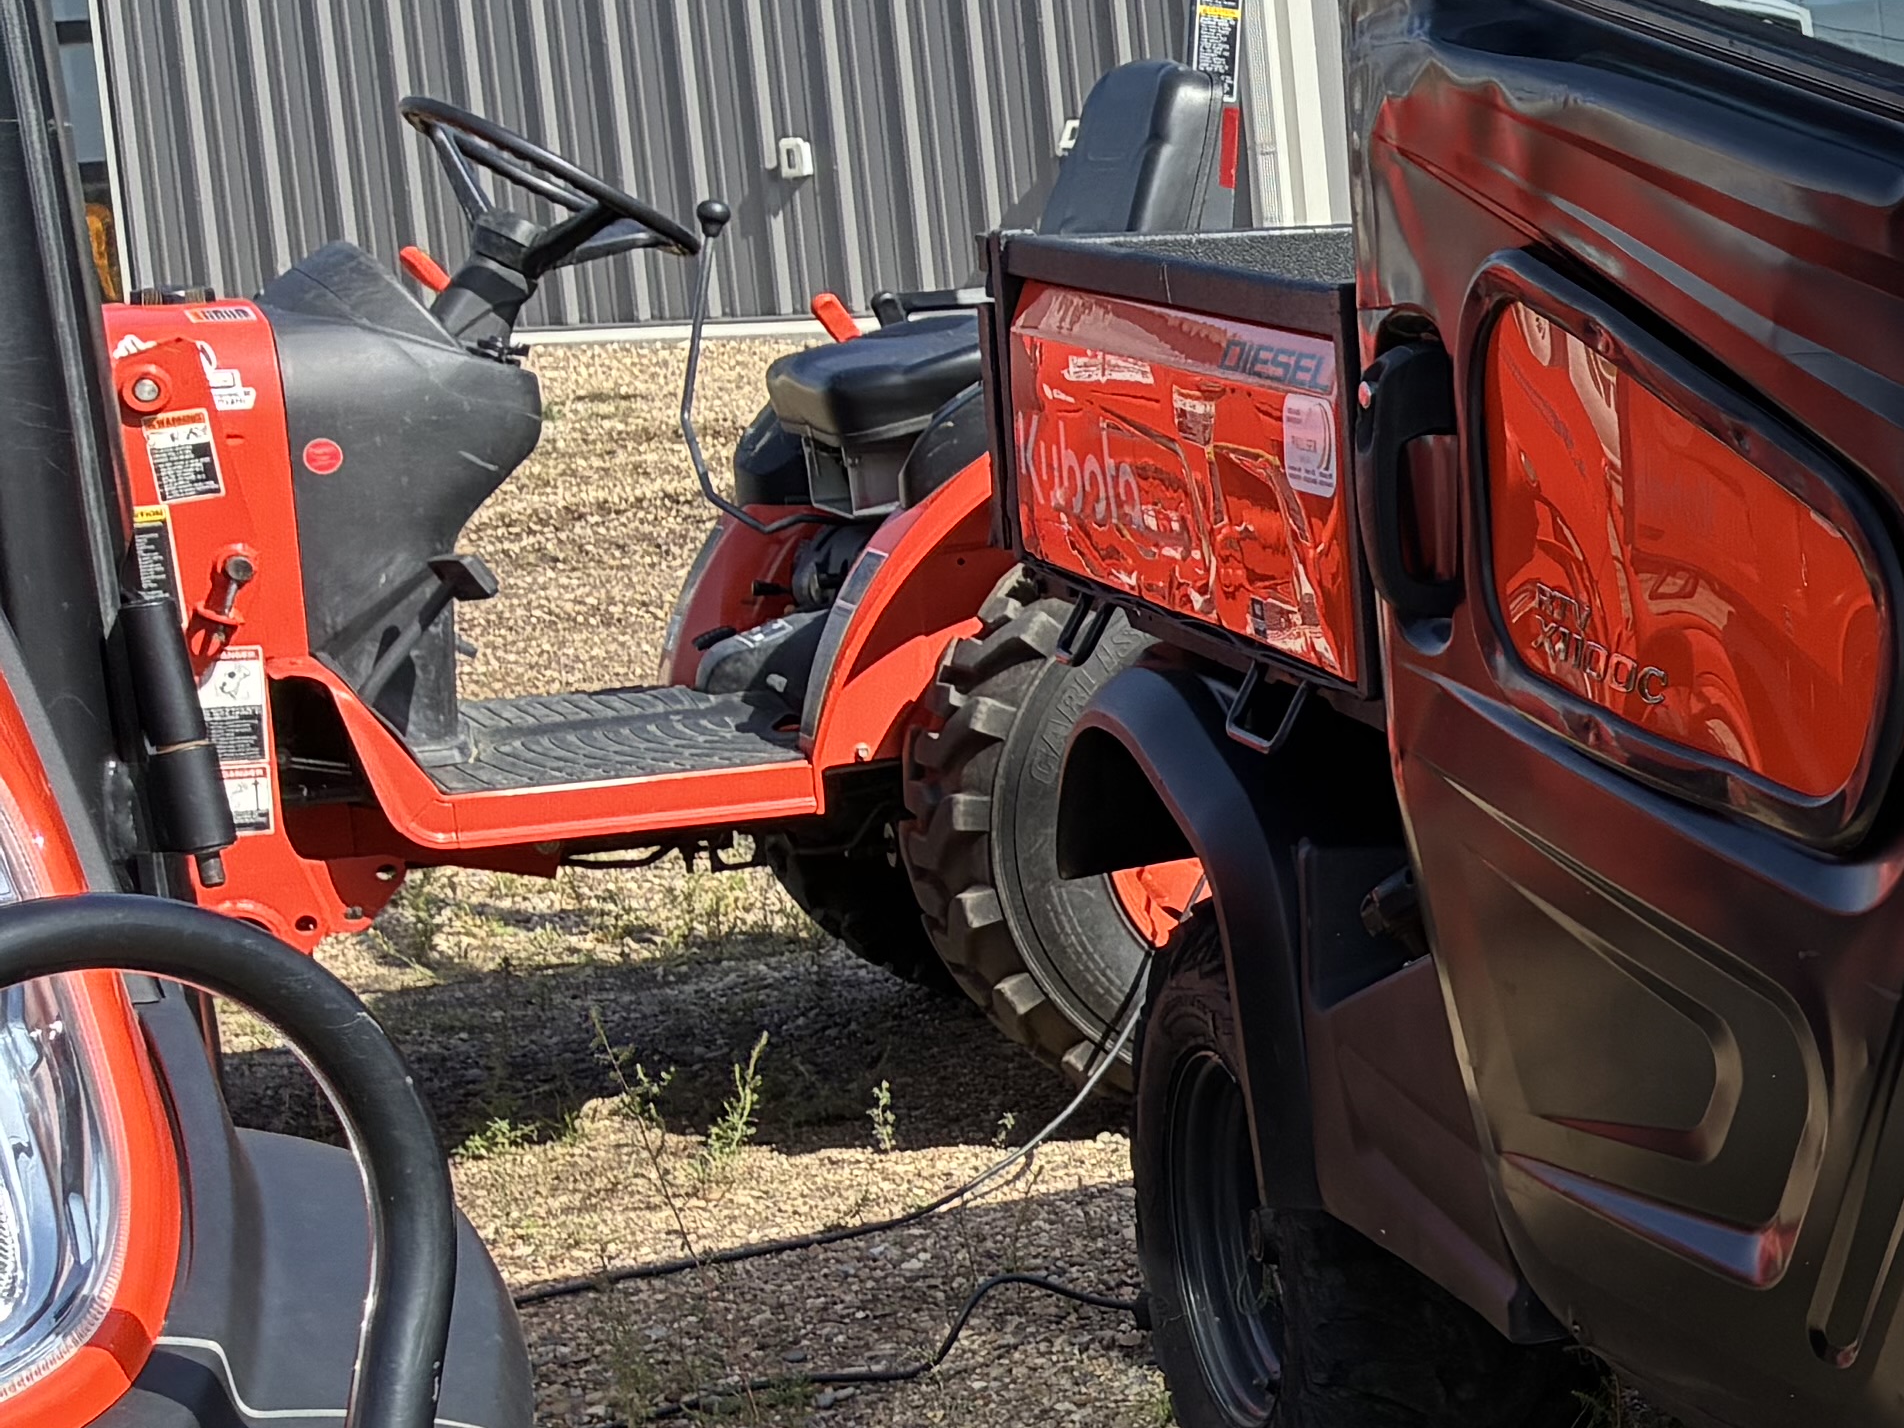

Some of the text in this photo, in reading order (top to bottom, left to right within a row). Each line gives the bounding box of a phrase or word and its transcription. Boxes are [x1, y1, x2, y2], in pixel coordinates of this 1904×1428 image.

[1219, 339, 1328, 391] DIESEL
[1017, 410, 1145, 534] Kubota
[1536, 583, 1591, 634] RTV
[1531, 615, 1668, 704] X1100C
